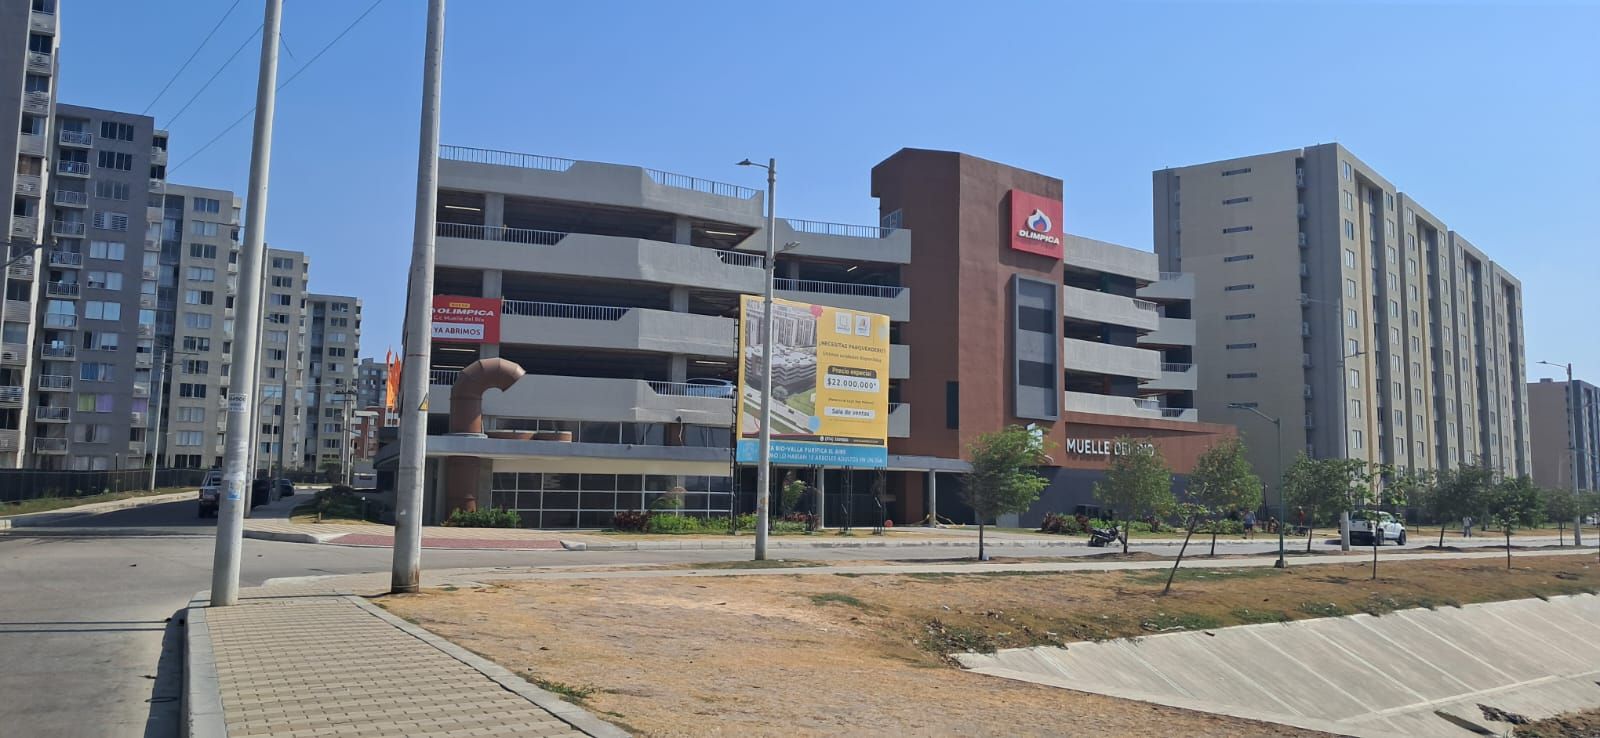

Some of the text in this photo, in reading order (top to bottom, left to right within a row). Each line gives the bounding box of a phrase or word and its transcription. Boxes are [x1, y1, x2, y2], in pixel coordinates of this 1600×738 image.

[1018, 229, 1060, 245] OLIMPICA
[437, 308, 494, 316] OLIMPICA
[444, 327, 481, 336] ABRIMOS
[1066, 438, 1110, 454] MUELLE
